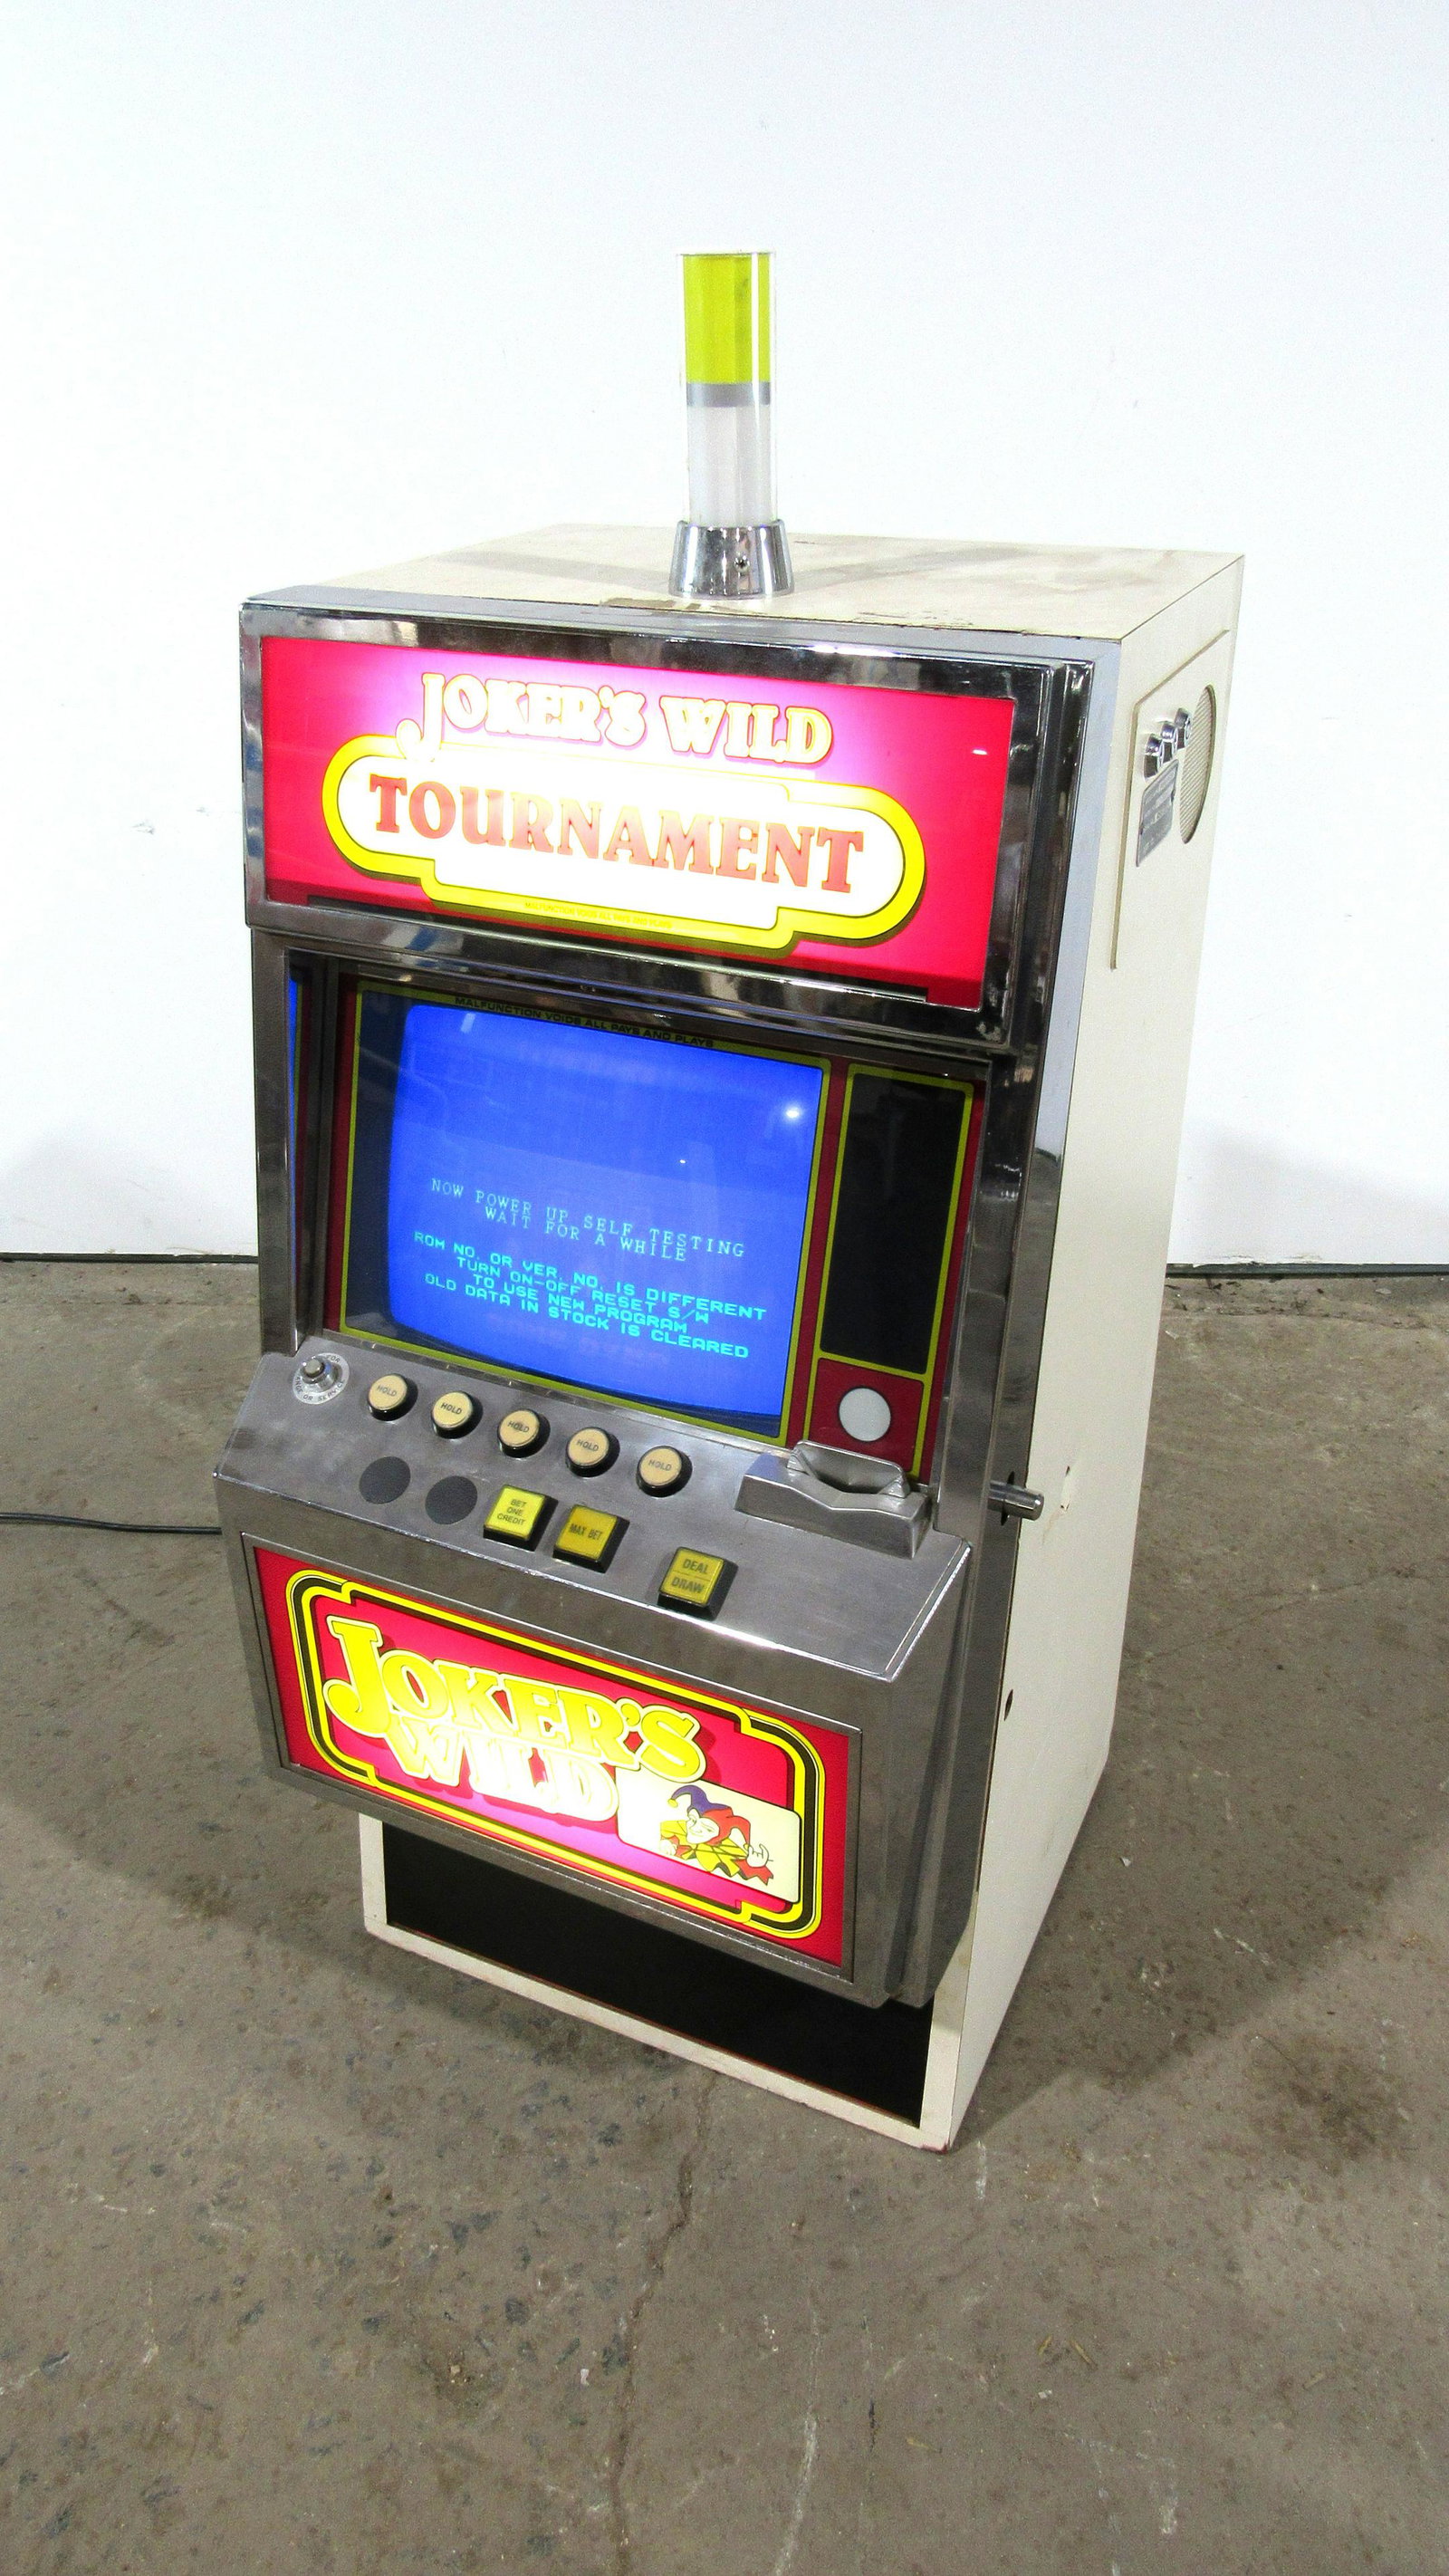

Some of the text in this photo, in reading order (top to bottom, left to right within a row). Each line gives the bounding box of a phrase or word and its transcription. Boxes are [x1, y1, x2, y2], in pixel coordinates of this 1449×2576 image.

[396, 672, 834, 764] JOKER'S WILD
[369, 773, 864, 894] TOURNAMENT
[455, 996, 714, 1048] MALFUNCTION VOIDS ALL PAYS AND PLAYS
[431, 1178, 744, 1257] NOW POWER UP SELF TESTING
[485, 1206, 686, 1261] WAIT FOR A WHILE
[413, 1232, 767, 1321] ROM NO. OR VER. NO. IS DIFFERENT
[456, 1256, 709, 1324] TURN ON-OFF RESET S/W
[425, 1273, 749, 1358] OLD DATA IN STOCK IS CLEARED
[473, 1274, 687, 1333] TO USE NEW PROGRAM
[376, 1385, 397, 1397] HOLD
[440, 1402, 463, 1415] HOLD
[507, 1420, 530, 1433] HOLD
[575, 1438, 600, 1452] HOLD
[648, 1459, 672, 1471] HOLD
[496, 1513, 526, 1525] CREDIT
[506, 1507, 524, 1516] ONE
[510, 1498, 527, 1508] BET
[569, 1523, 603, 1541] MAX BET
[682, 1559, 708, 1574] DEAL
[671, 1576, 705, 1594] DRAW
[322, 1614, 707, 1783] JOKER'S
[386, 1717, 619, 1821] WILD
